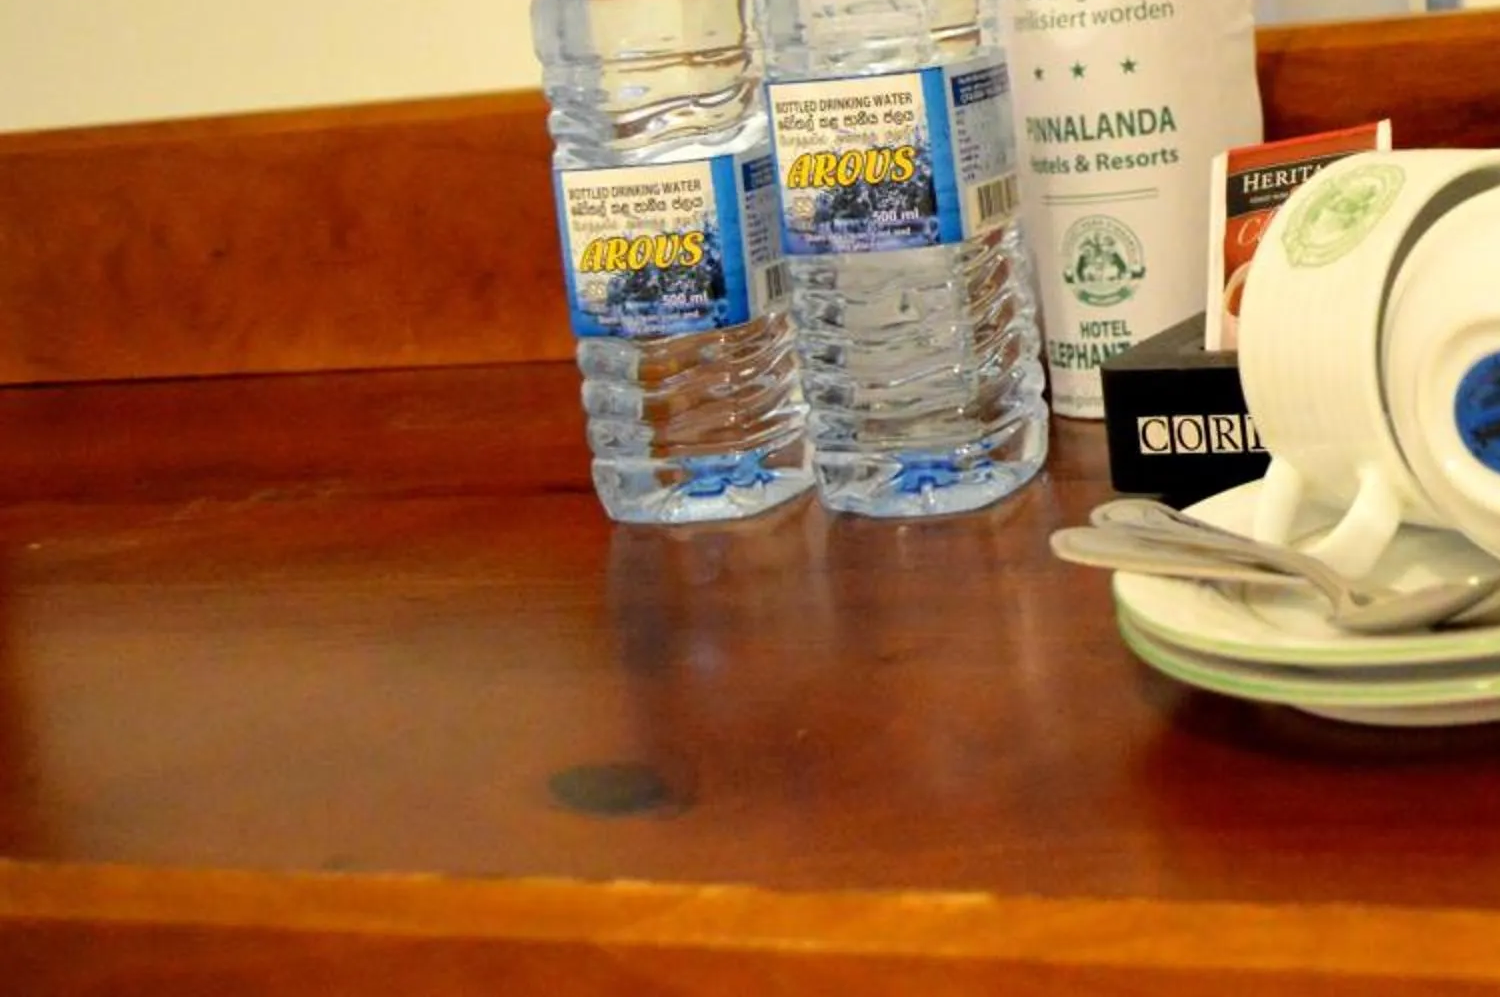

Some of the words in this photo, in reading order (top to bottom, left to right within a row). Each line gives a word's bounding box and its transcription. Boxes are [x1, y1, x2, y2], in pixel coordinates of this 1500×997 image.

[1092, 1, 1175, 27] worden
[776, 100, 818, 114] BOTTLED
[820, 95, 871, 112] DRINKING
[872, 91, 913, 107] WATER
[786, 144, 917, 190] AROUS
[1074, 154, 1091, 174] &
[1096, 147, 1180, 172] Resorts
[612, 183, 661, 198] DRINKING
[662, 178, 702, 194] WATER
[579, 229, 705, 274] AROUS
[1079, 319, 1133, 340] HOTEL
